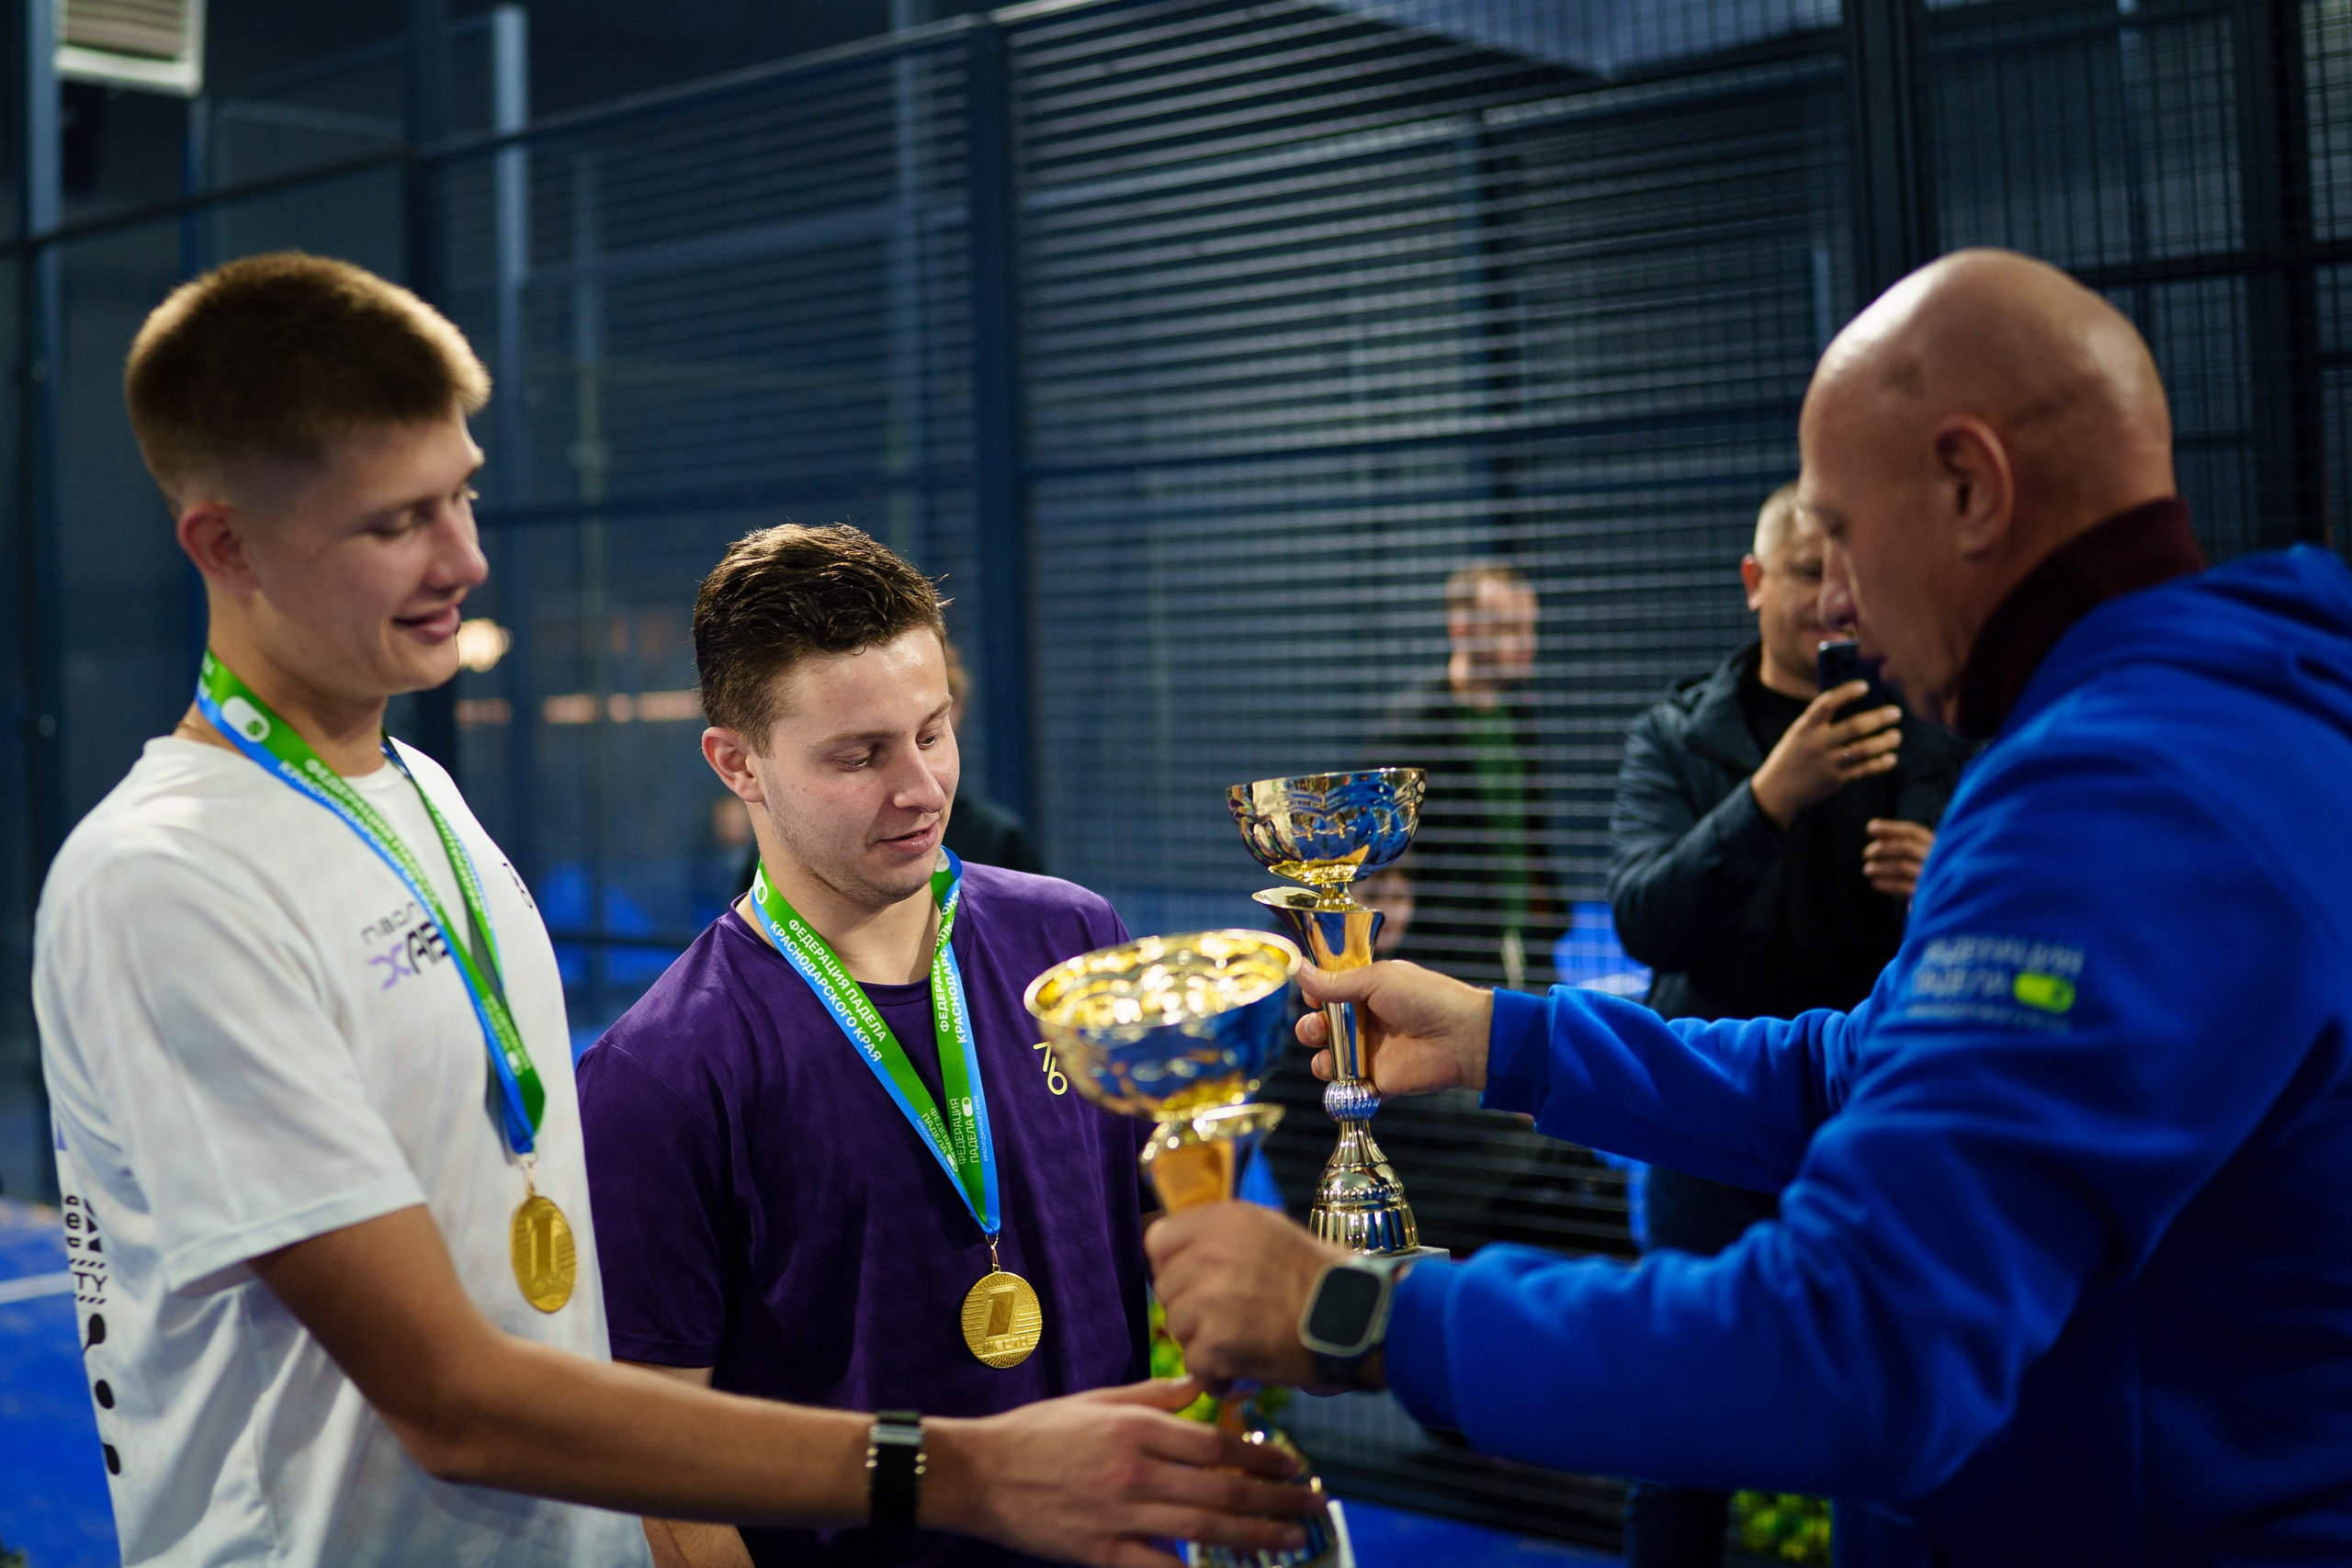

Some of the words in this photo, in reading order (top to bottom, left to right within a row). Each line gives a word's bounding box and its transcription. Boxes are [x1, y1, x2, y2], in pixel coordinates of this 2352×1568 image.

[770, 920, 858, 1028] КРАСНОДАРСКОГО
[853, 1026, 883, 1062] КРАЯ
[788, 919, 851, 989] ФЕДЕРАЦИЯ
[845, 987, 887, 1043] ПАДЕЛА
[933, 958, 949, 1032] ФЕДЕРАЦ
[922, 1112, 947, 1154] ПАДЕЛА
[930, 1108, 957, 1165] ФЕДЕРАЦИ
[949, 1098, 967, 1164] ФЕДЕРАЦИЯ
[965, 1119, 979, 1163] ПАДЕЛА
